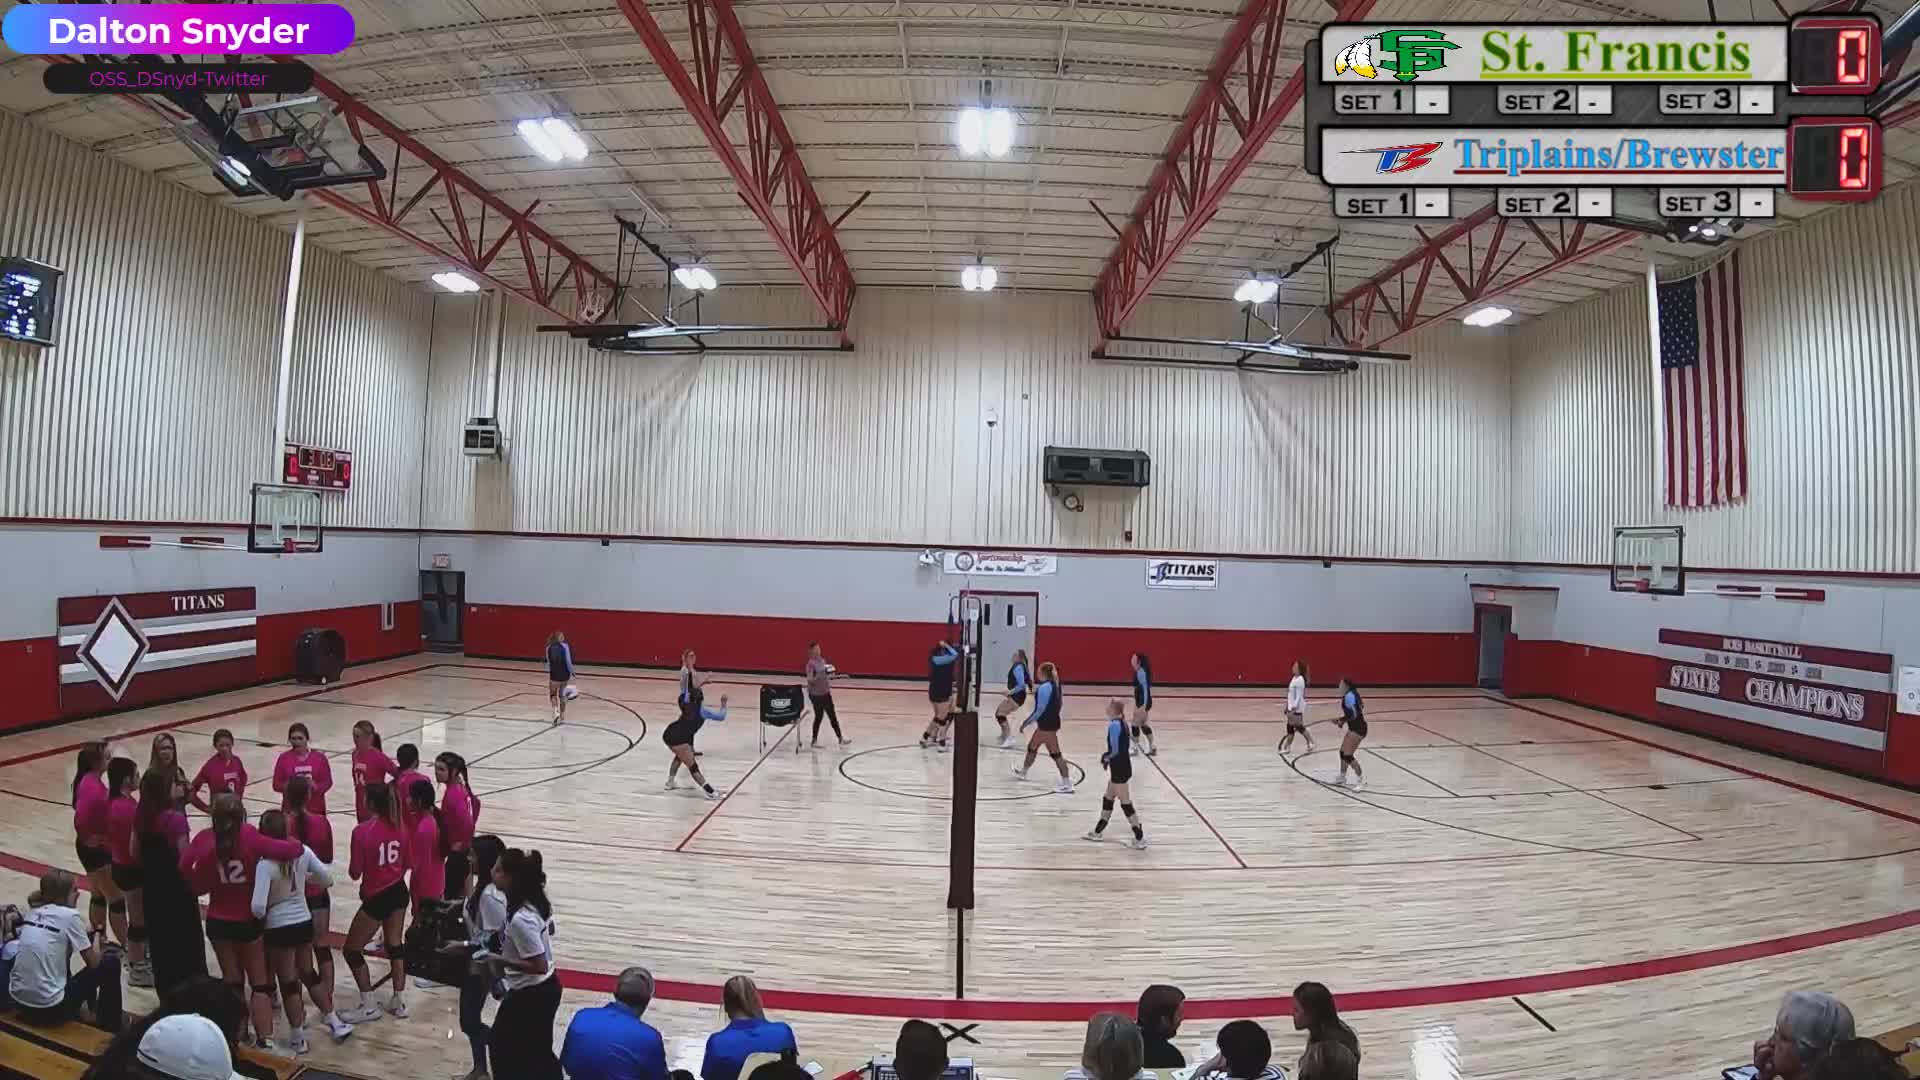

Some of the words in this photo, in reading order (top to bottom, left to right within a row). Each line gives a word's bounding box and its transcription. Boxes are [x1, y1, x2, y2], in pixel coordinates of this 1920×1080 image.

[1167, 564, 1216, 576] TITANS
[171, 593, 226, 612] TITANS
[1744, 640, 1803, 659] BASKETBALL
[1669, 664, 1721, 695] STATE
[1745, 677, 1865, 722] CHAMPIONS
[379, 840, 401, 866] 16
[219, 859, 247, 884] 12
